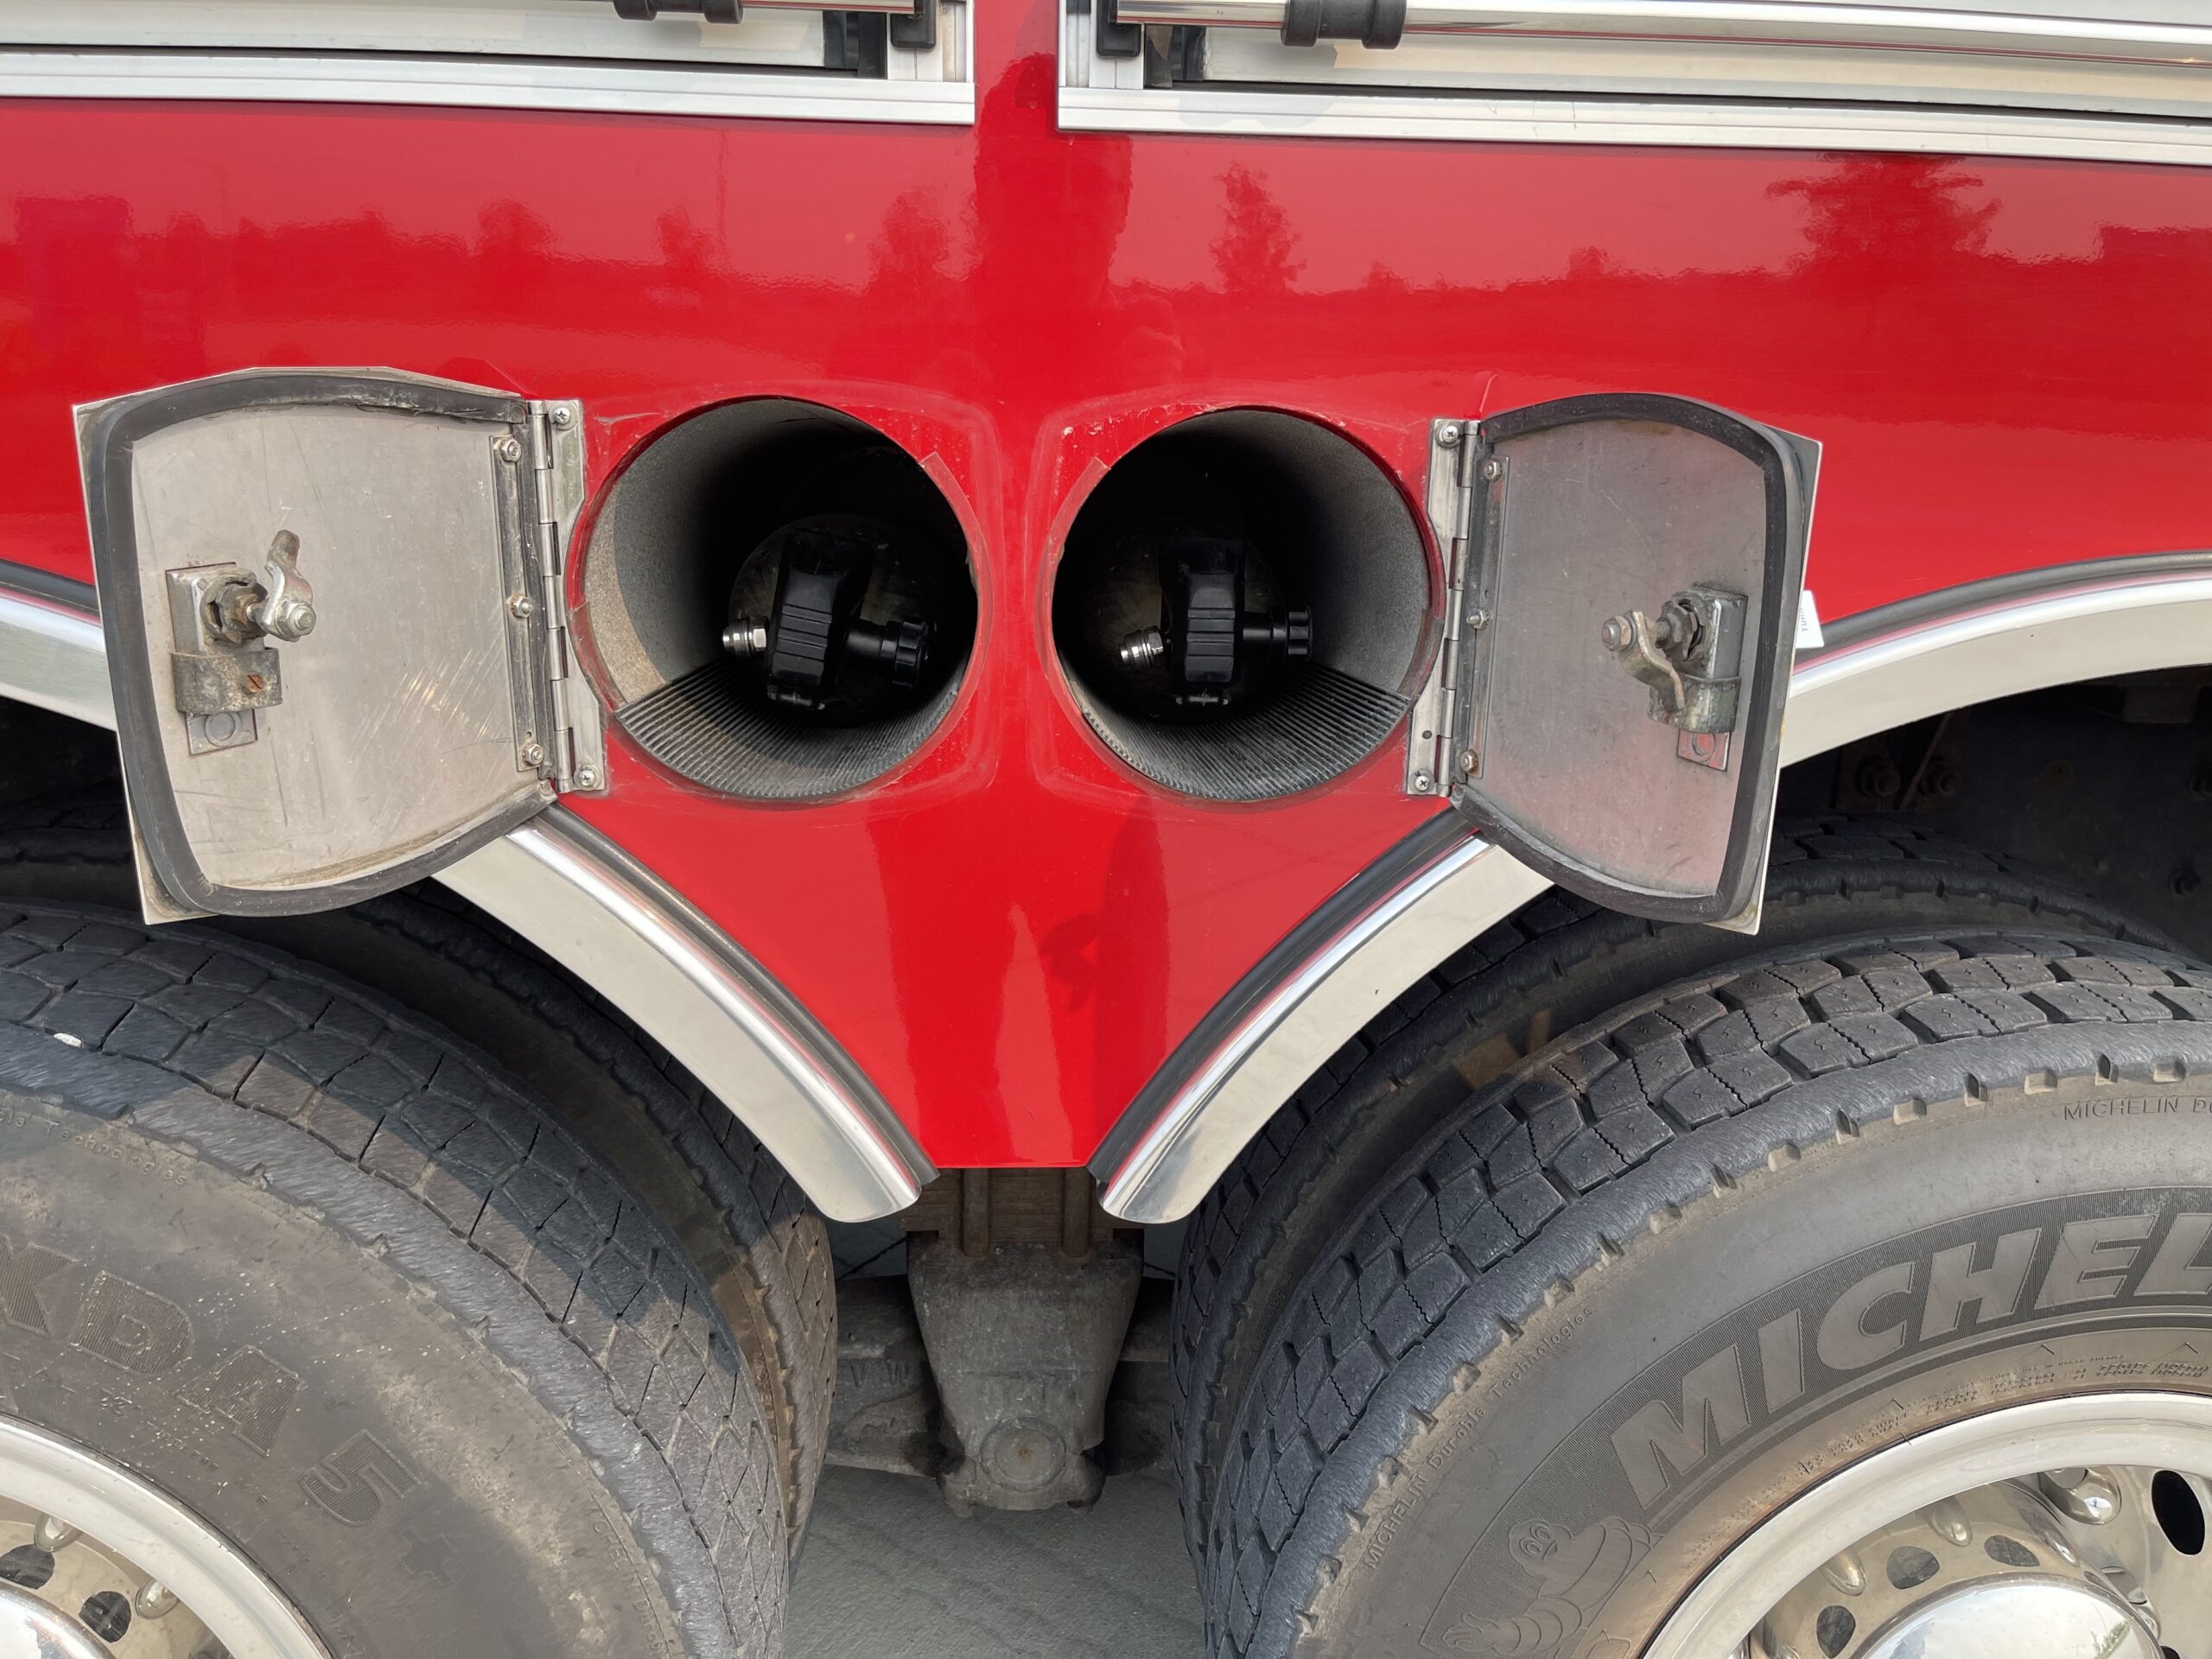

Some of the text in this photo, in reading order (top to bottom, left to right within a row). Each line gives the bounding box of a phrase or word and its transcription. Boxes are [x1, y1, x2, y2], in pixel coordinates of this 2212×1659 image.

[2063, 1096, 2178, 1121] MICHELIN
[45, 1121, 187, 1185] Technologies
[1363, 1305, 1595, 1569] MICHELIN Durable Technologies
